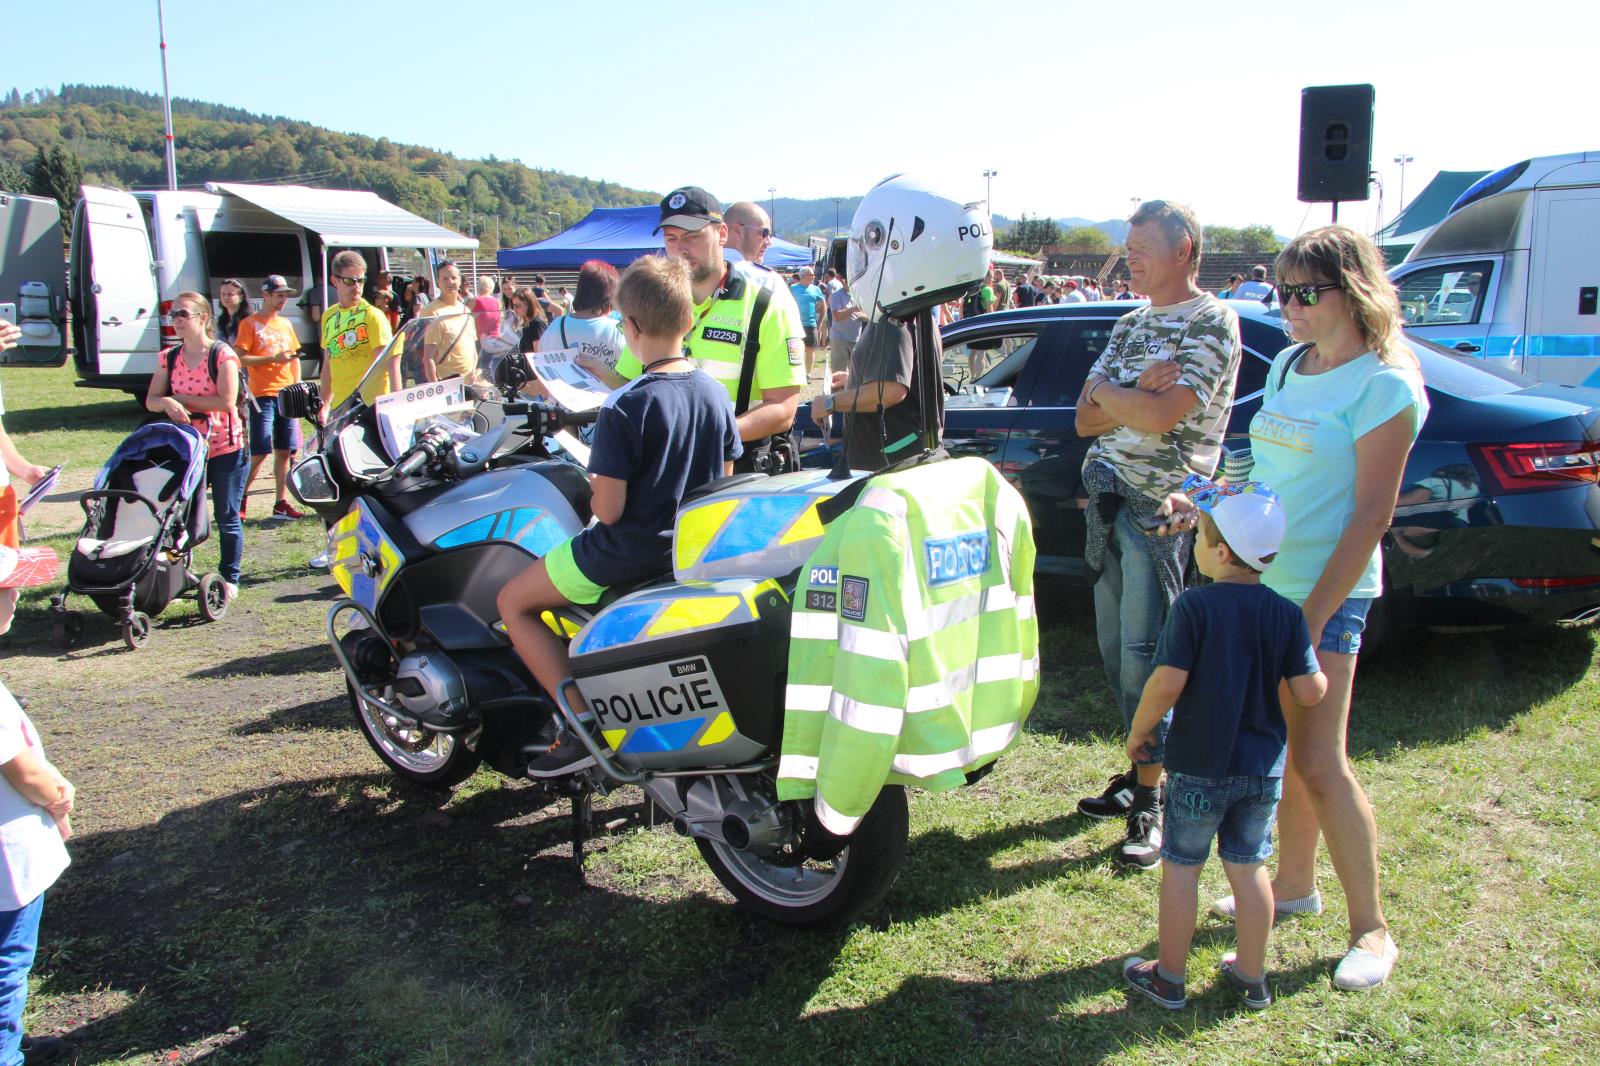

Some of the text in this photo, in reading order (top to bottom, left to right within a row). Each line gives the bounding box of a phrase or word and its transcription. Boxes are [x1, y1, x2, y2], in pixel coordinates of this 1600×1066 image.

[958, 223, 992, 242] POL
[706, 328, 738, 342] 312258
[677, 663, 697, 675] BMW
[590, 678, 719, 726] POLICIE
